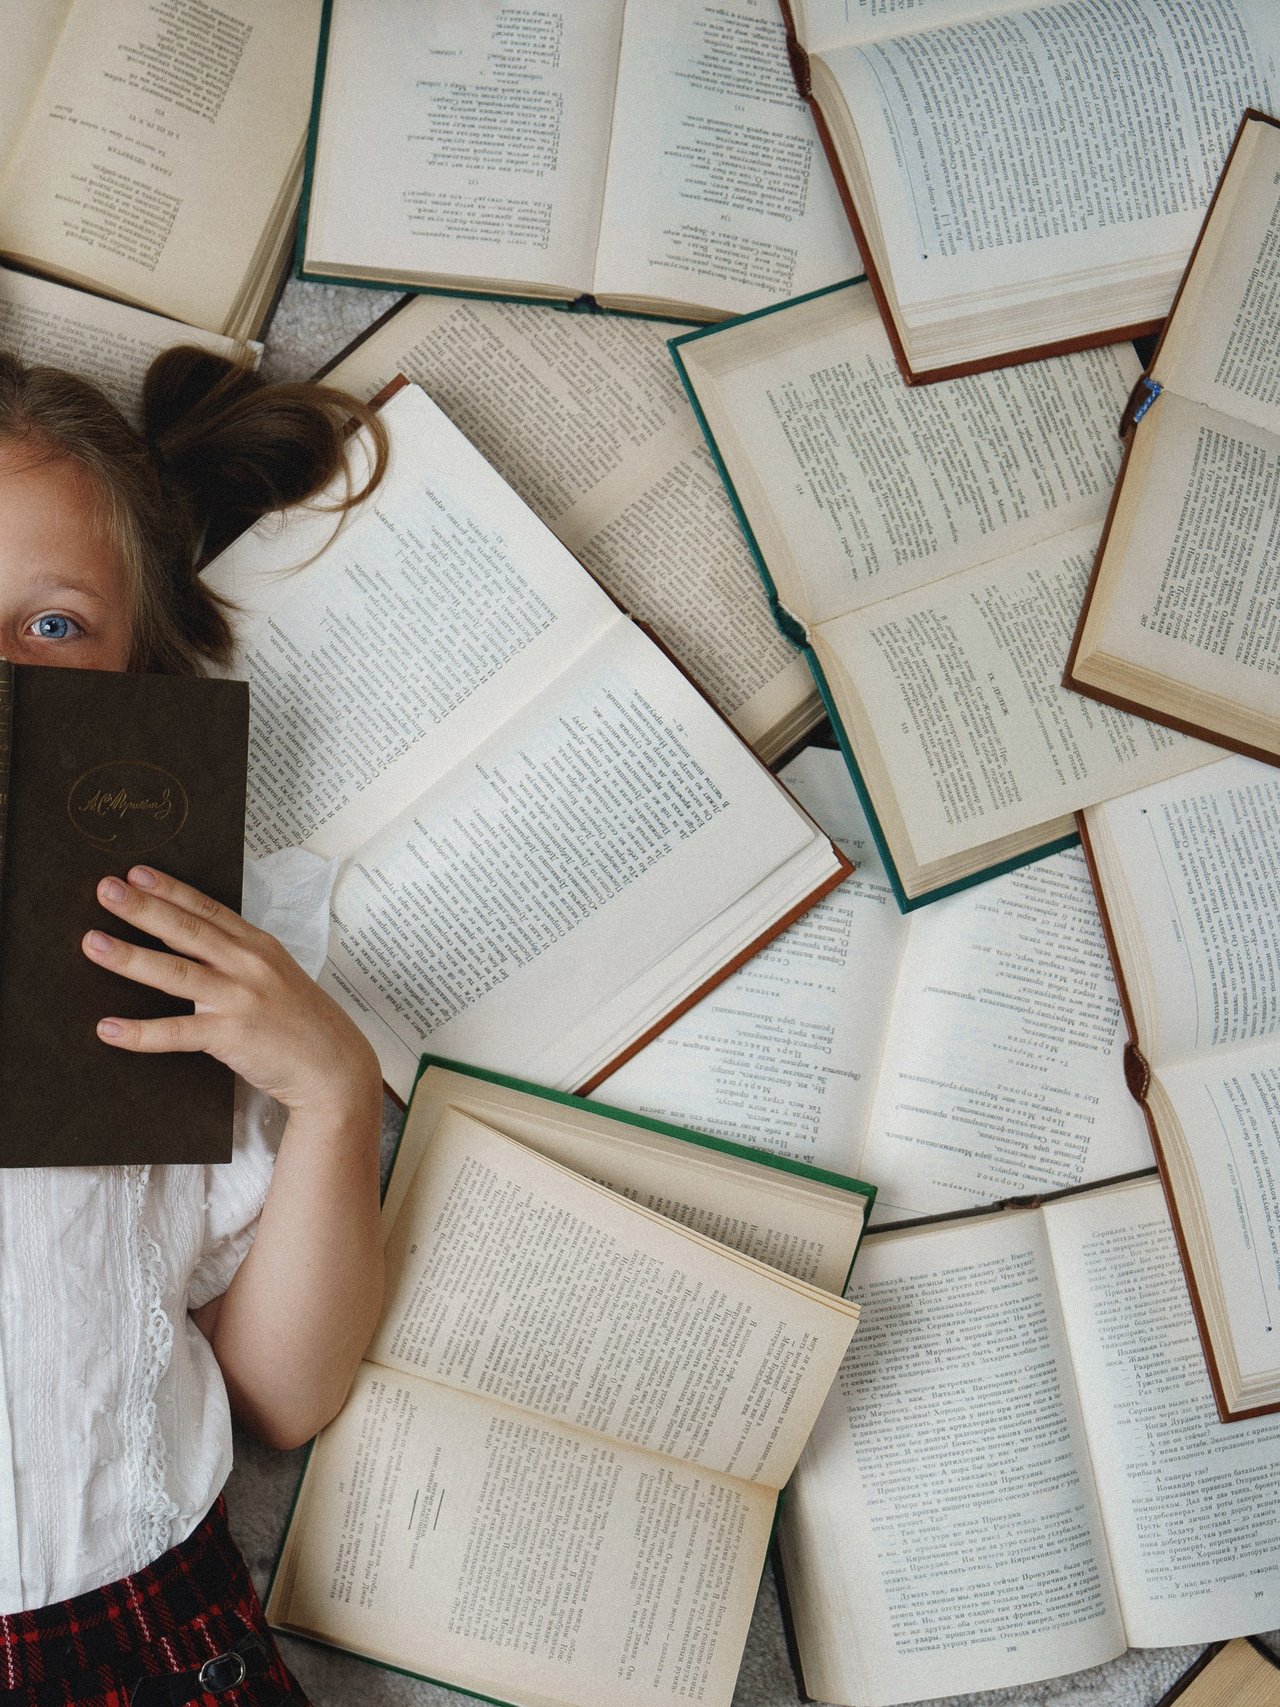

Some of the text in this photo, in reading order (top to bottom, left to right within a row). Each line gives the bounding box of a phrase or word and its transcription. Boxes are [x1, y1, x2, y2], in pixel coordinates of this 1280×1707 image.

[795, 484, 805, 496] 514
[1192, 495, 1208, 536] столкнулся
[1209, 483, 1245, 598] передовыми людьми поручили
[1223, 505, 1256, 606] покинул соборную церковь.
[1172, 584, 1184, 608] Пусть
[926, 607, 943, 633] Альбер
[944, 641, 964, 670] Морсер
[959, 669, 975, 697] выбрал
[970, 697, 981, 713] для
[977, 712, 991, 735] своей
[985, 735, 999, 763] матери
[997, 770, 1007, 785] для
[1003, 785, 1014, 805] себя,
[991, 685, 1009, 716] ДЕЛЕЖ
[899, 721, 909, 734] 515
[549, 755, 566, 774] коня
[640, 750, 657, 769] одни
[518, 779, 534, 799] коня,
[564, 773, 584, 794] добра
[665, 779, 691, 810] времечка
[533, 799, 553, 821] добра
[690, 809, 705, 828] Ехал
[600, 815, 618, 836] седло
[559, 831, 591, 869] Дунаюшко
[625, 845, 639, 861] себе
[588, 866, 615, 899] Сошел-то
[977, 1130, 1086, 1163] Грозный царь Максимилиан,
[993, 1144, 1036, 1160] повелитель,
[1038, 1155, 1070, 1167] великий
[915, 1296, 942, 1306] Когда
[946, 1288, 987, 1301] начинали,
[990, 1280, 1023, 1294] разведка
[1026, 1276, 1039, 1284] нам
[701, 1288, 719, 1322] нарядном
[691, 1322, 705, 1347] летнем
[664, 1306, 703, 1389] Окажите мне последнюю
